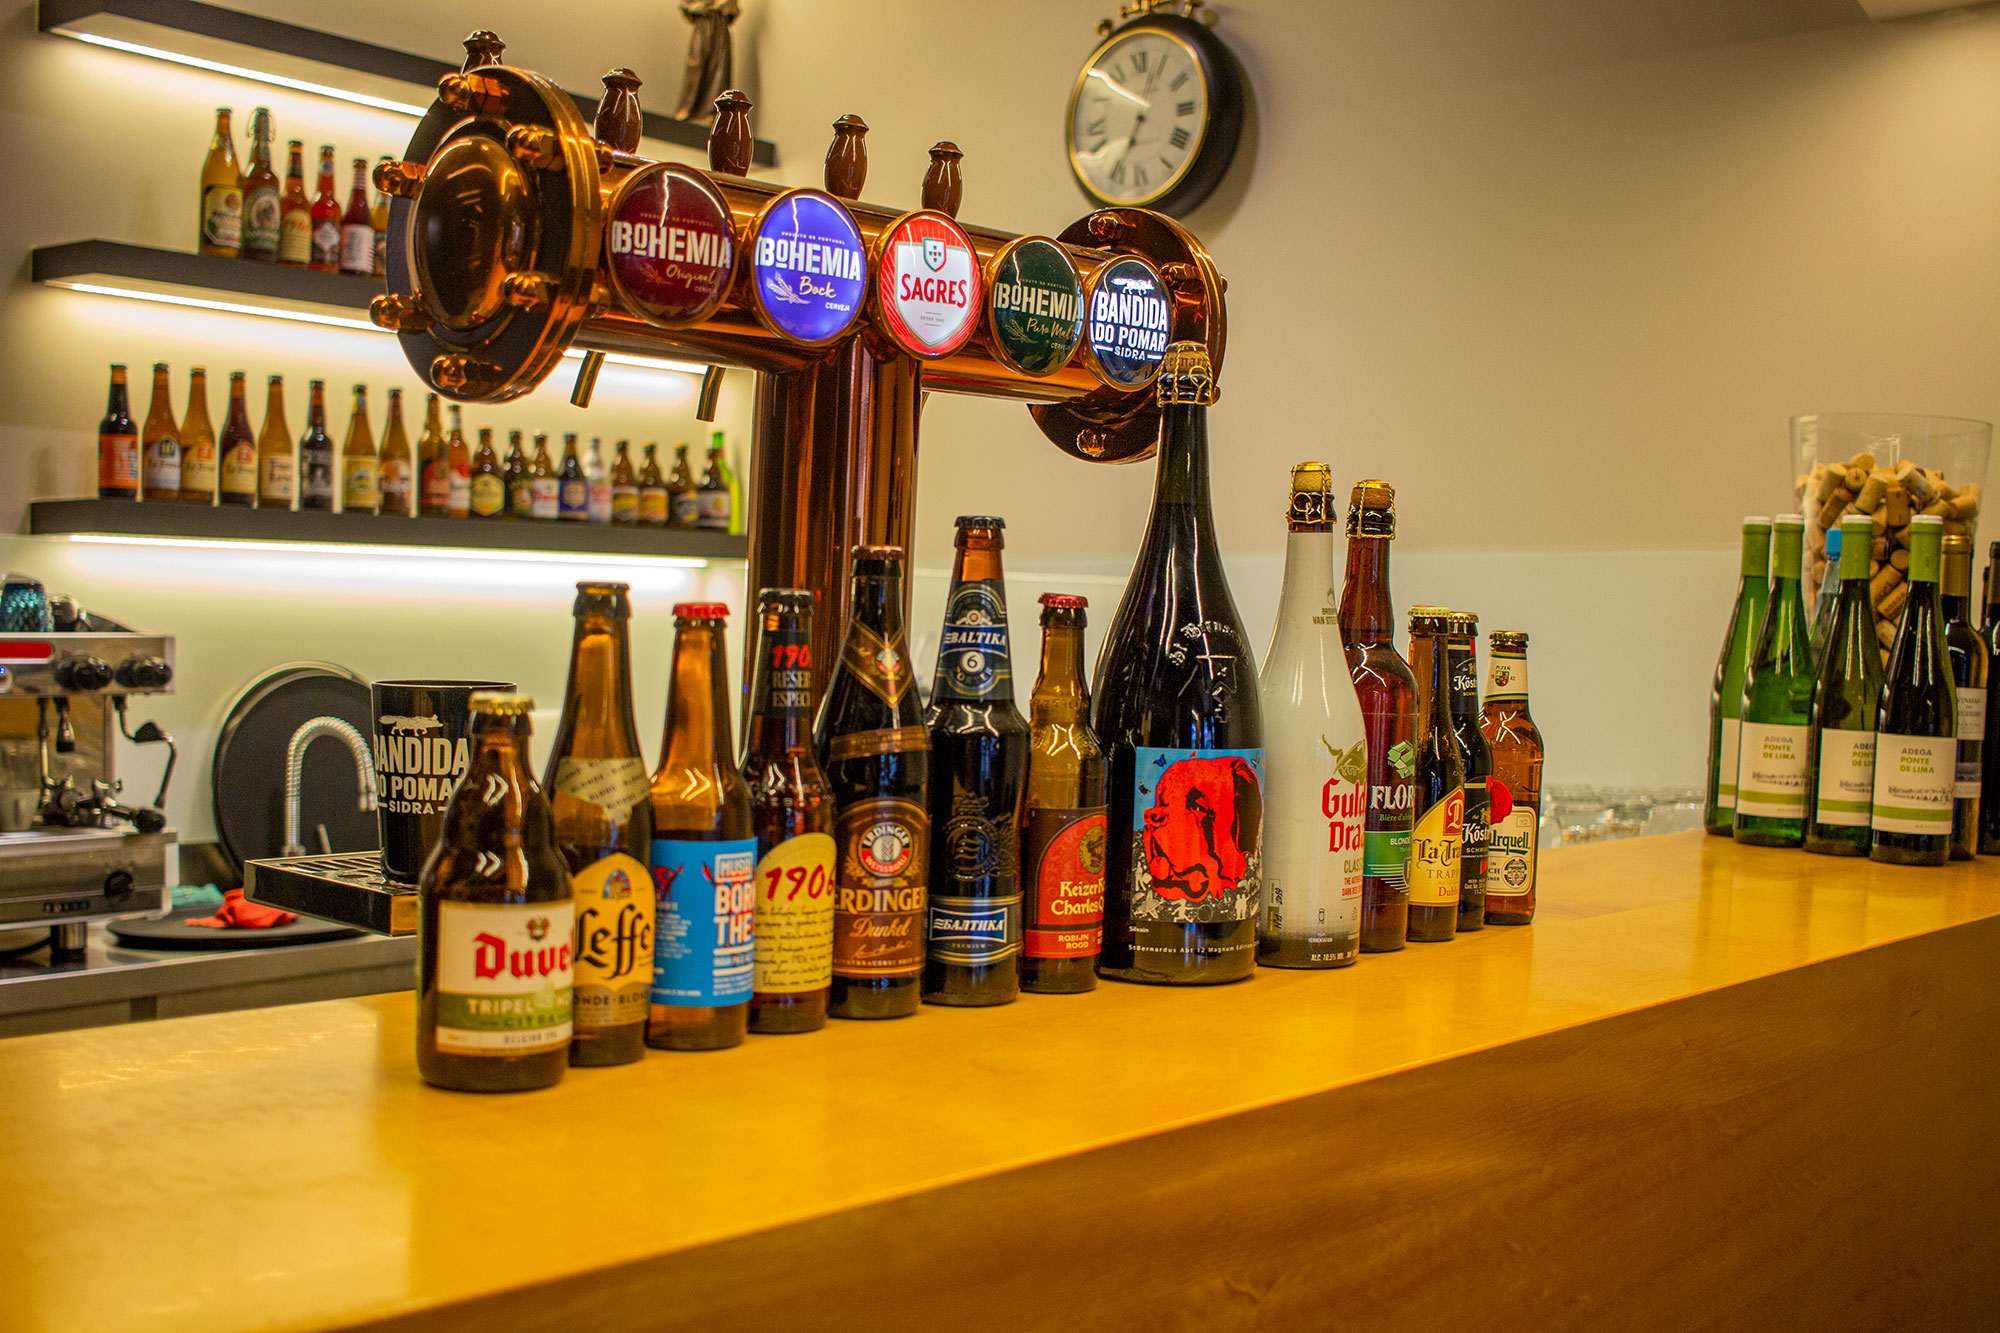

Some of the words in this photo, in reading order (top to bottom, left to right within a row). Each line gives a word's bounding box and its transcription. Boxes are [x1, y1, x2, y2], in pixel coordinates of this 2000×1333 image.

[612, 221, 731, 269] BOHEMIA
[759, 236, 860, 281] BOHEMIA
[666, 264, 716, 289] Original
[799, 276, 837, 298] Bock
[900, 273, 967, 308] SAGRES
[1097, 291, 1168, 332] BANDIDA
[1095, 322, 1115, 344] DO
[1118, 325, 1167, 352] POMAR
[1114, 346, 1146, 361] SIDRA
[951, 631, 1006, 645] BALTIKA
[773, 644, 812, 668] 190
[967, 655, 977, 669] 6
[1764, 735, 1793, 743] ADEGA
[374, 734, 470, 776] BANDIDA
[1775, 752, 1796, 760] LIMA
[1900, 756, 1930, 764] PONTE
[1901, 748, 1932, 756] ADEGA
[391, 774, 465, 801] POMA
[388, 799, 434, 815] SIDRA
[1380, 813, 1397, 822] Bière
[863, 824, 910, 847] ERDINGER
[1414, 838, 1438, 869] La
[1060, 881, 1099, 897] Keizer
[1051, 899, 1098, 915] Charles
[850, 916, 912, 938] Dunkel
[943, 919, 1005, 932] БАЛТИКА
[574, 904, 653, 980] Leffe
[1058, 934, 1089, 942] ROBIJN
[1066, 941, 1089, 949] ROOD
[1197, 945, 1206, 953] 12
[467, 998, 534, 1015] TRIPEL
[503, 1014, 559, 1028] CITRA
